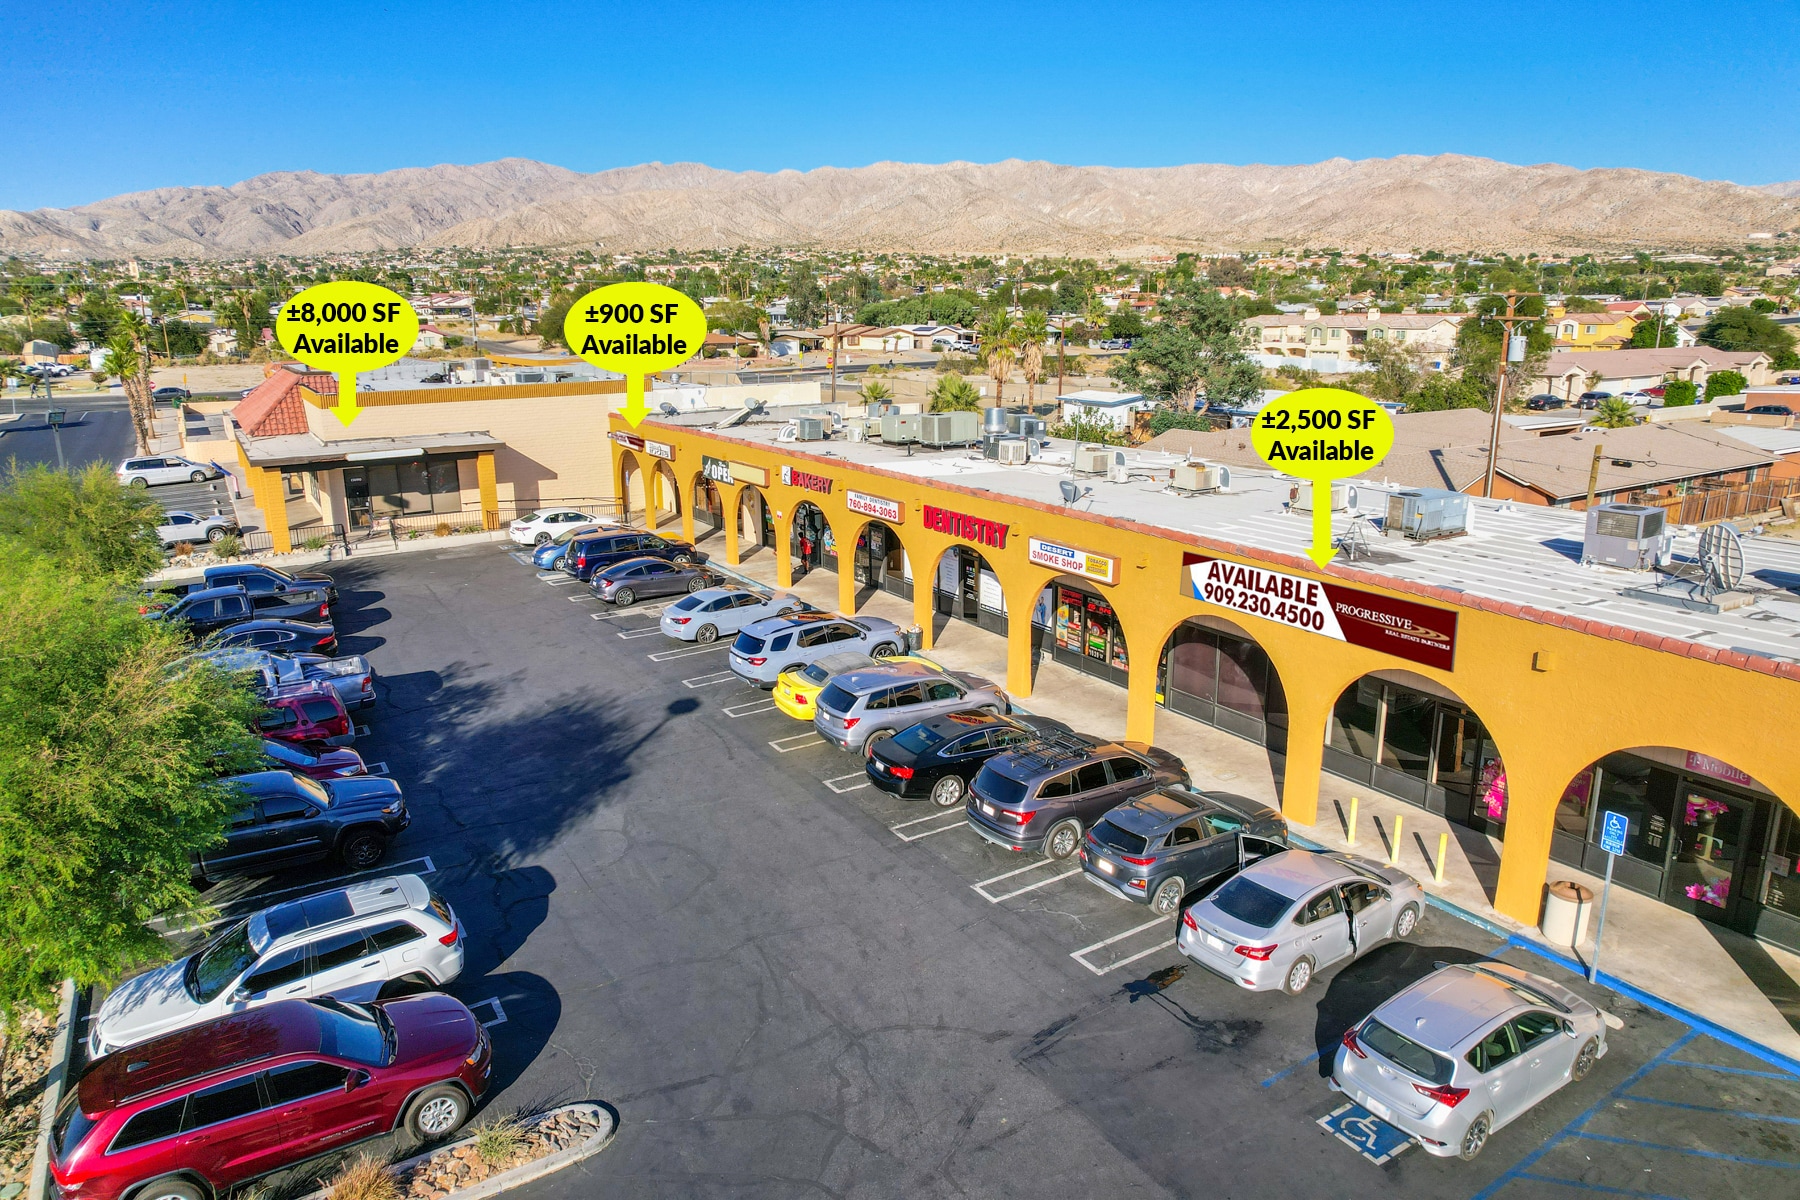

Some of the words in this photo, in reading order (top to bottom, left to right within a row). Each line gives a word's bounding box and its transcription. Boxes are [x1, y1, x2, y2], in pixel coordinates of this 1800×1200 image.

[791, 469, 832, 495] BAKERY
[848, 498, 897, 520] 760-894-3063
[923, 504, 1009, 549] DENTISTRY
[1032, 550, 1060, 565] SMOKE
[1061, 558, 1083, 571] SHOP
[1041, 544, 1073, 558] DESERT
[1207, 561, 1319, 607] AVAILABLE
[1204, 582, 1325, 631] 909.230.4500
[1335, 602, 1412, 630] PROGRESSIVE
[1385, 629, 1399, 638] REAL
[1421, 638, 1450, 651] PARTNERS
